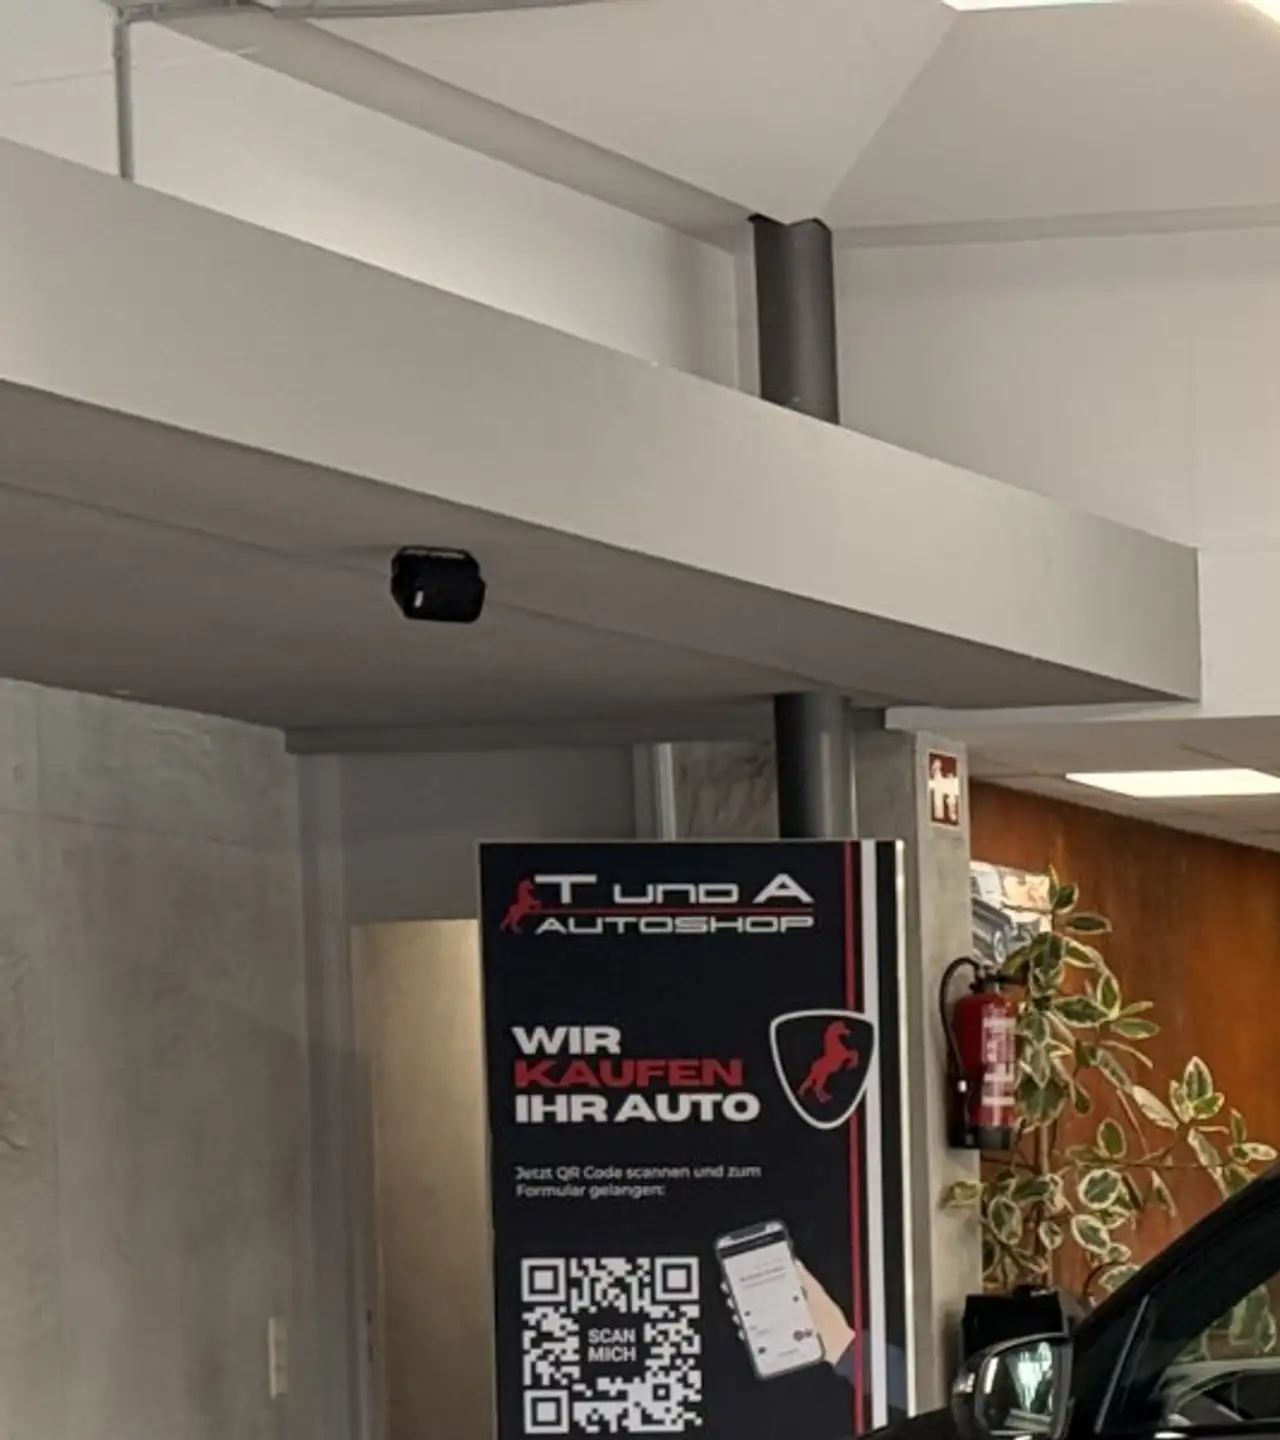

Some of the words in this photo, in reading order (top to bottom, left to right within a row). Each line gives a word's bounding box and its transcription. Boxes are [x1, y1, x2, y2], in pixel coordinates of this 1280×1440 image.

[534, 874, 597, 904] T
[752, 873, 814, 904] A
[534, 916, 814, 935] AUTOSHOP
[511, 1026, 622, 1055] WIR
[514, 1059, 743, 1088] KAUFEN
[515, 1094, 608, 1123] IHR
[612, 1093, 761, 1122] AUTO
[515, 1166, 552, 1180] Jetzt
[556, 1166, 580, 1180] QR
[583, 1166, 622, 1180] Code
[626, 1167, 690, 1179] scannen
[693, 1165, 724, 1178] und
[727, 1166, 762, 1178] zum
[516, 1184, 586, 1197] Formular
[589, 1184, 666, 1200] gelangen:
[588, 1328, 636, 1343] SCAN
[588, 1346, 637, 1362] MICH
